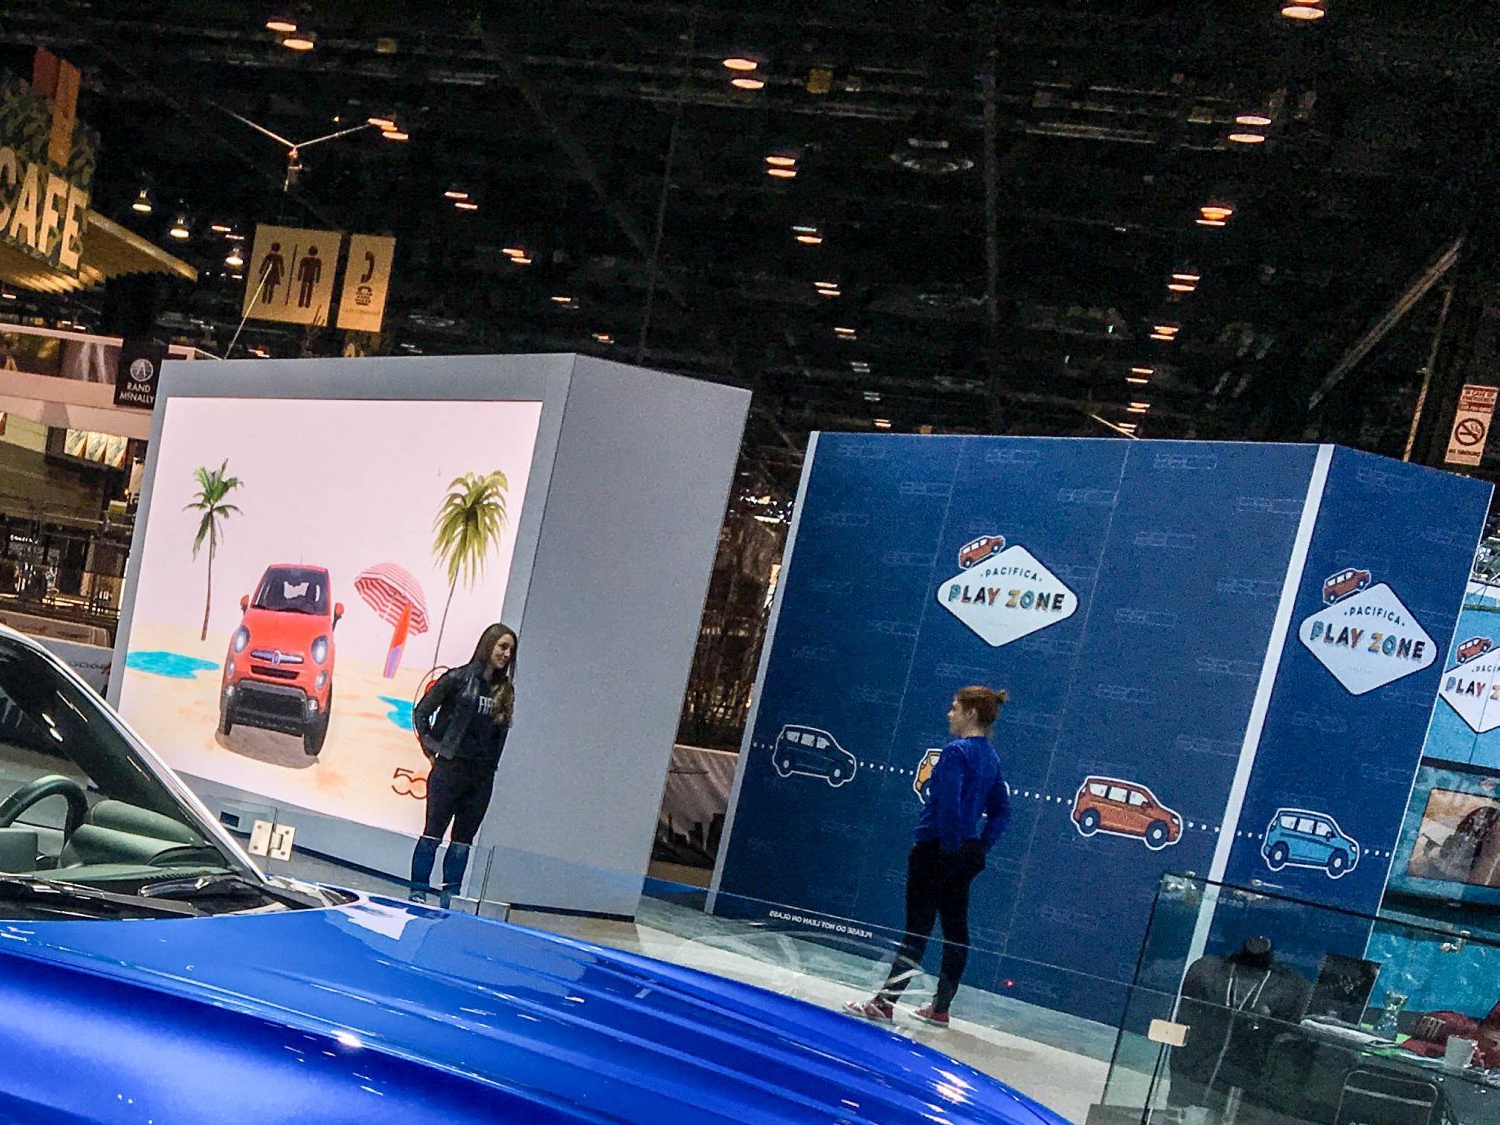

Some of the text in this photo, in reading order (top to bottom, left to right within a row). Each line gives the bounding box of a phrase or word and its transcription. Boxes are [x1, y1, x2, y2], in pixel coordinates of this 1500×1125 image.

[126, 382, 151, 393] RAND
[985, 566, 1038, 581] PACIFICA
[947, 583, 1066, 612] PLAY ZONE
[1345, 605, 1400, 625] PACIFICA
[1309, 620, 1426, 660] PLAY ZONE
[1444, 675, 1487, 698] PLAY
